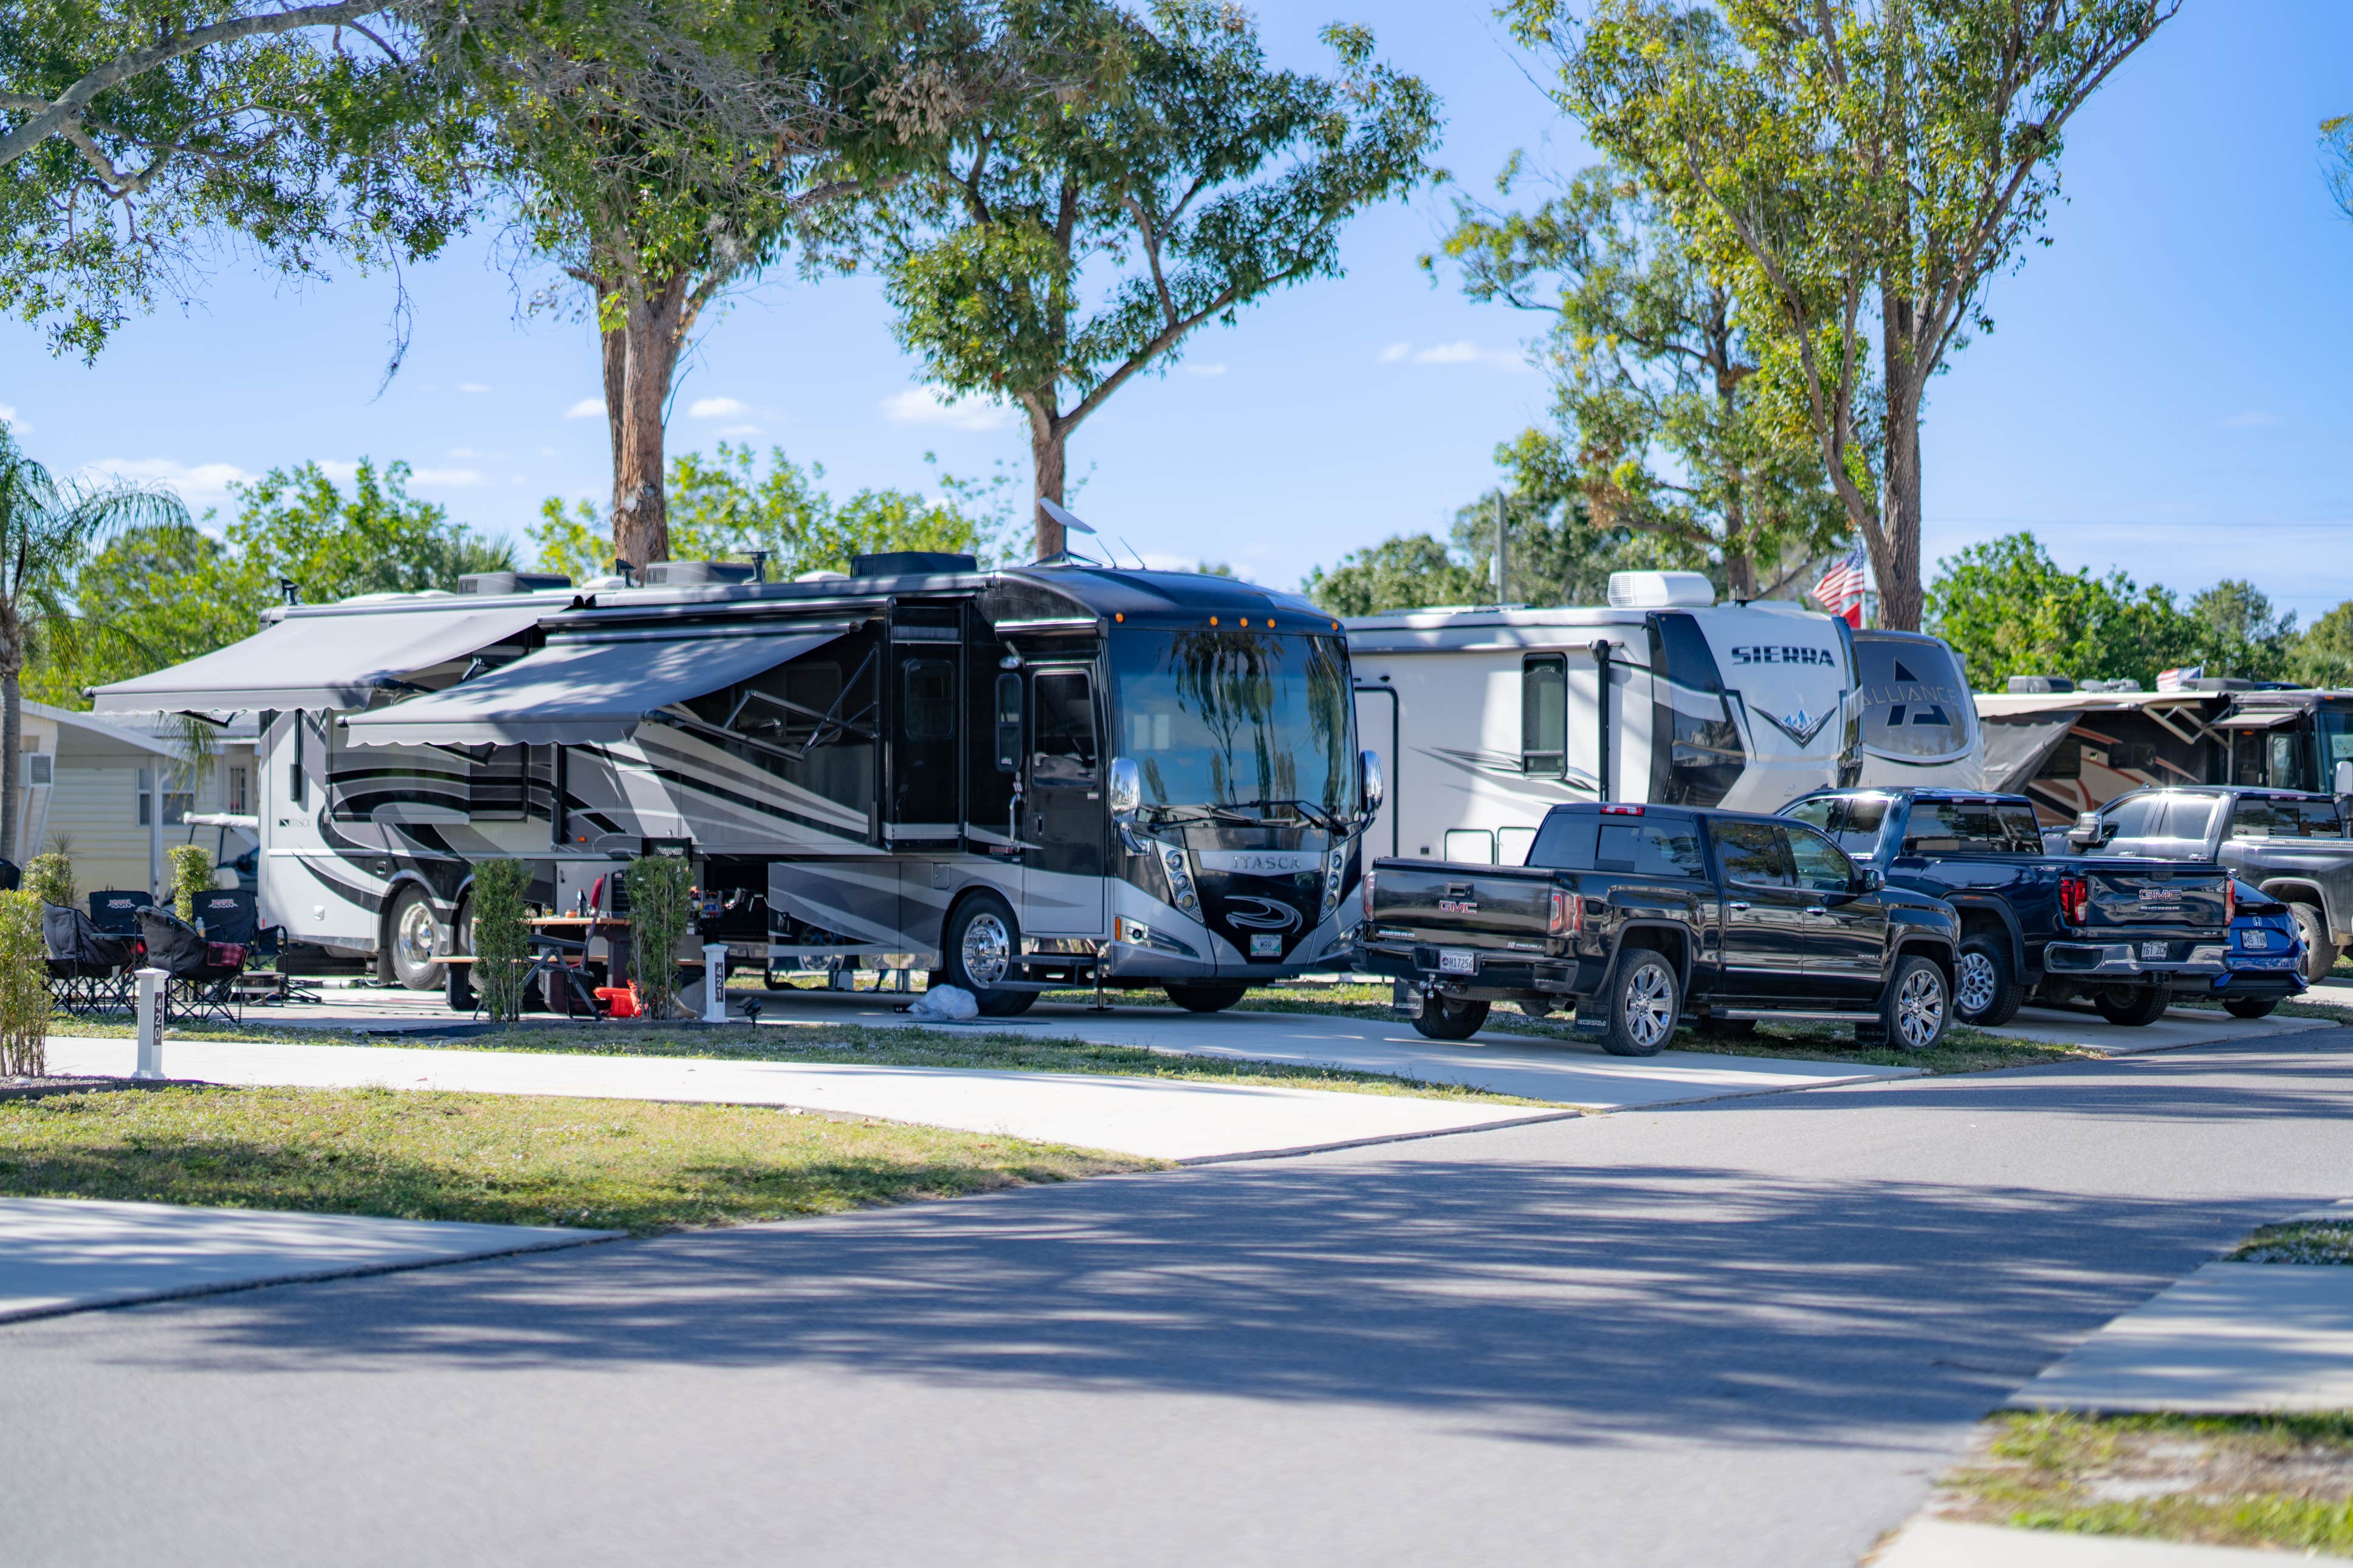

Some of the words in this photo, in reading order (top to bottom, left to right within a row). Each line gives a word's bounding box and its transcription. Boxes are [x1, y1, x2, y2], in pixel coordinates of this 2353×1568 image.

[1731, 646, 1835, 668] SIERRA
[290, 818, 311, 827] ITASCA
[1232, 855, 1300, 869] ITASCA
[2139, 889, 2182, 900] GMC
[108, 899, 136, 909] ICON
[208, 898, 238, 909] ICON
[1439, 900, 1477, 914] GMC
[2143, 945, 2153, 955] Y61
[1449, 957, 1472, 969] H17256
